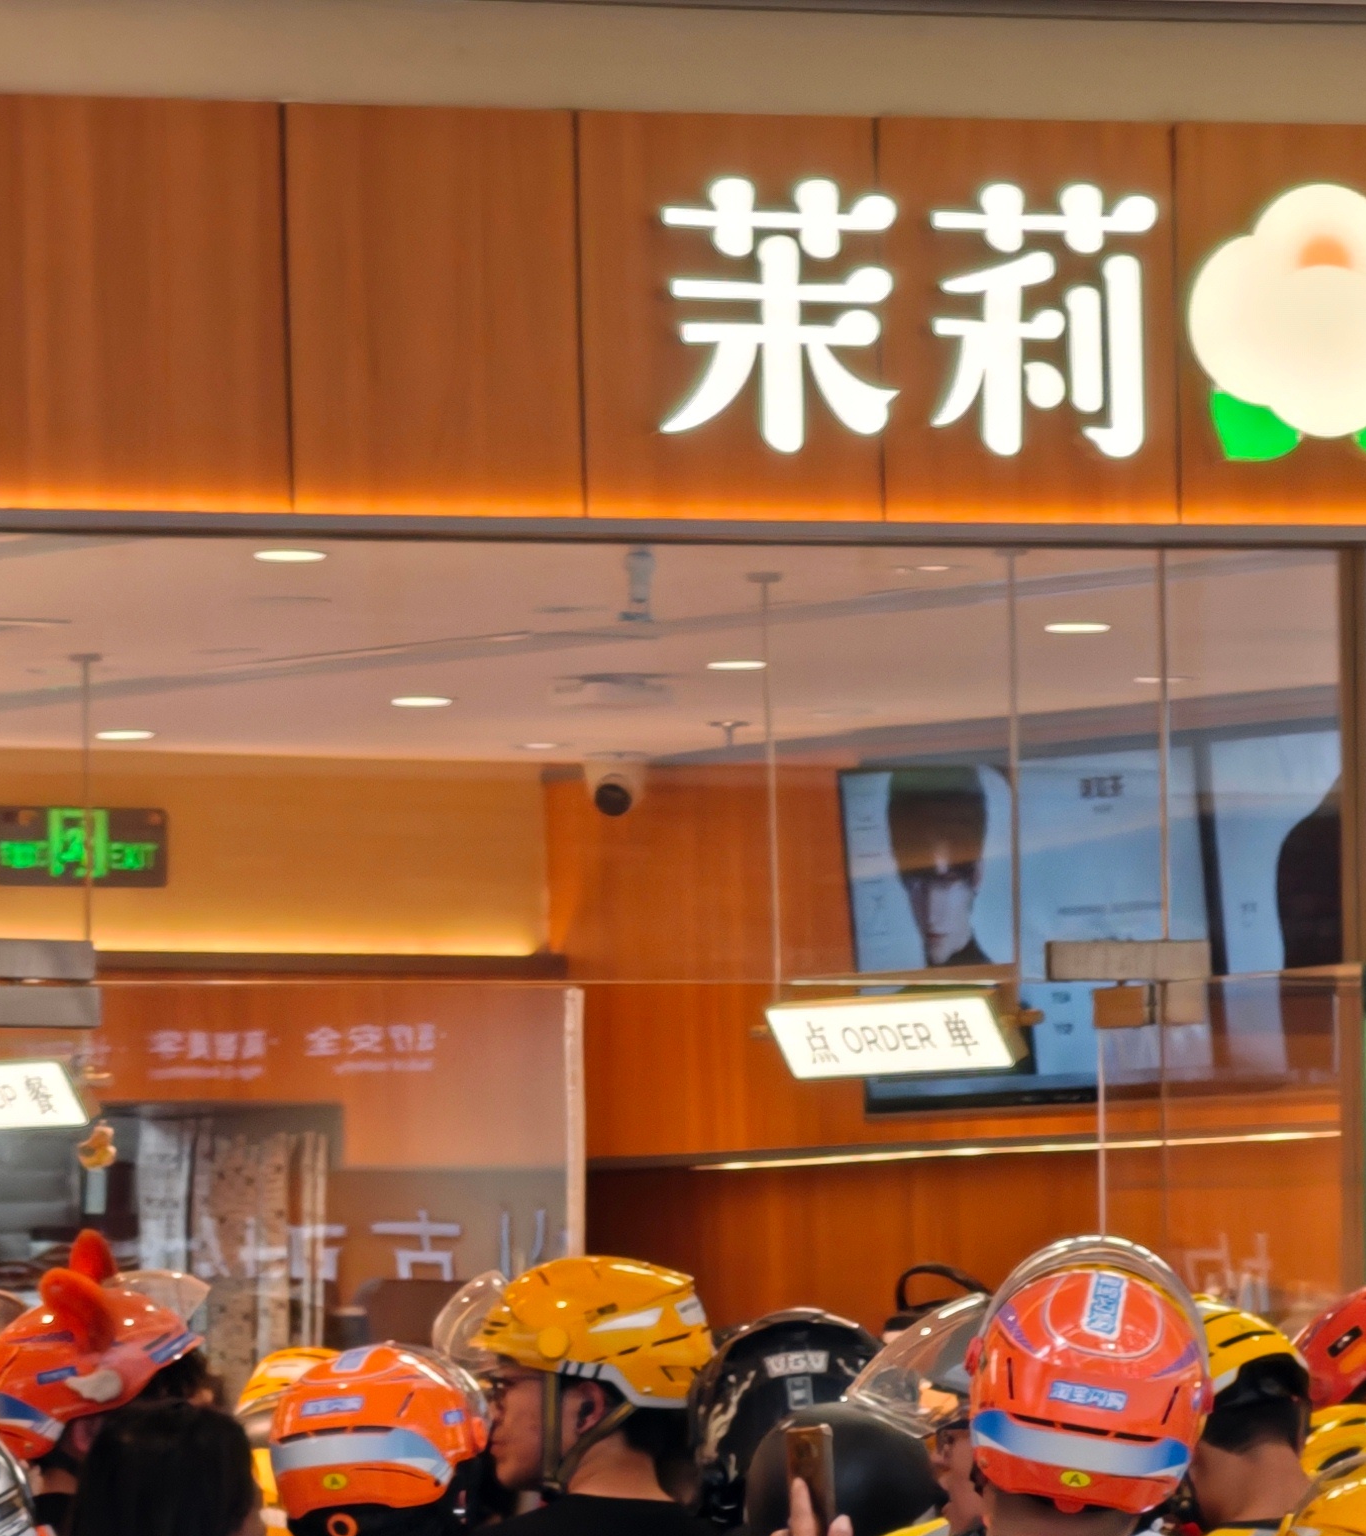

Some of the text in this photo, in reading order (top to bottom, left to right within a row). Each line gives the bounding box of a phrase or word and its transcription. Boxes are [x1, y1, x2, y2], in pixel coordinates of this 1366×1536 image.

[659, 178, 1158, 458] 茉莉
[804, 1011, 980, 1065] 点 ORDER 单
